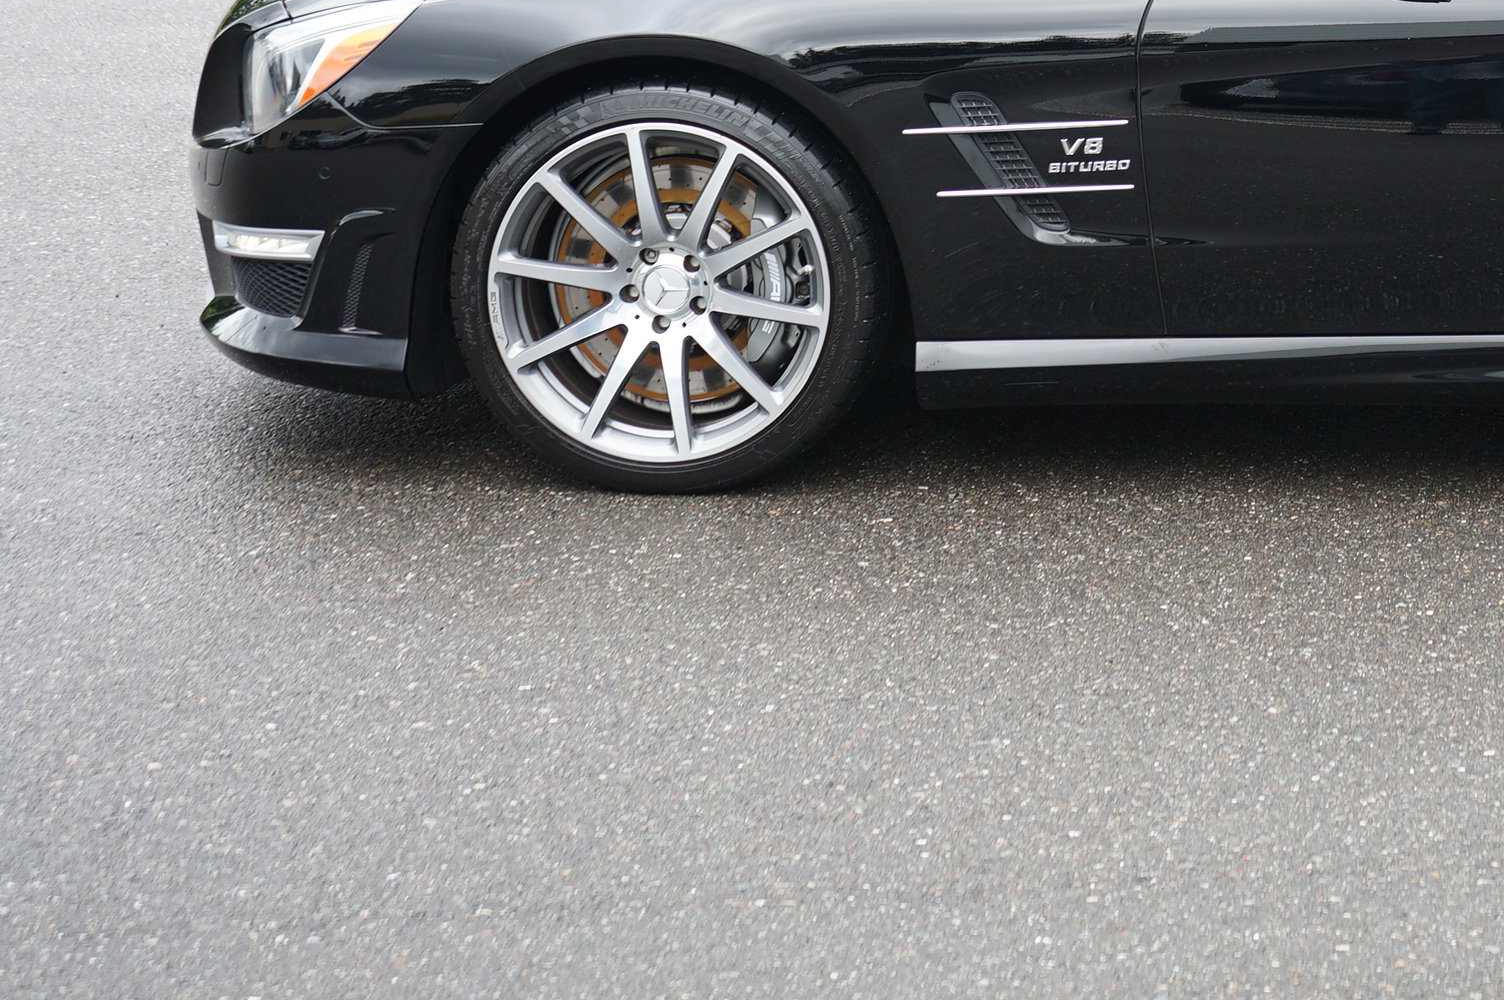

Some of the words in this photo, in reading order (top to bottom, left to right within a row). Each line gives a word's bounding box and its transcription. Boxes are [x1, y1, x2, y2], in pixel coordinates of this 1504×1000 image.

[631, 94, 751, 128] MICHELIN
[1060, 137, 1104, 156] V8
[1048, 159, 1131, 173] BITURBO
